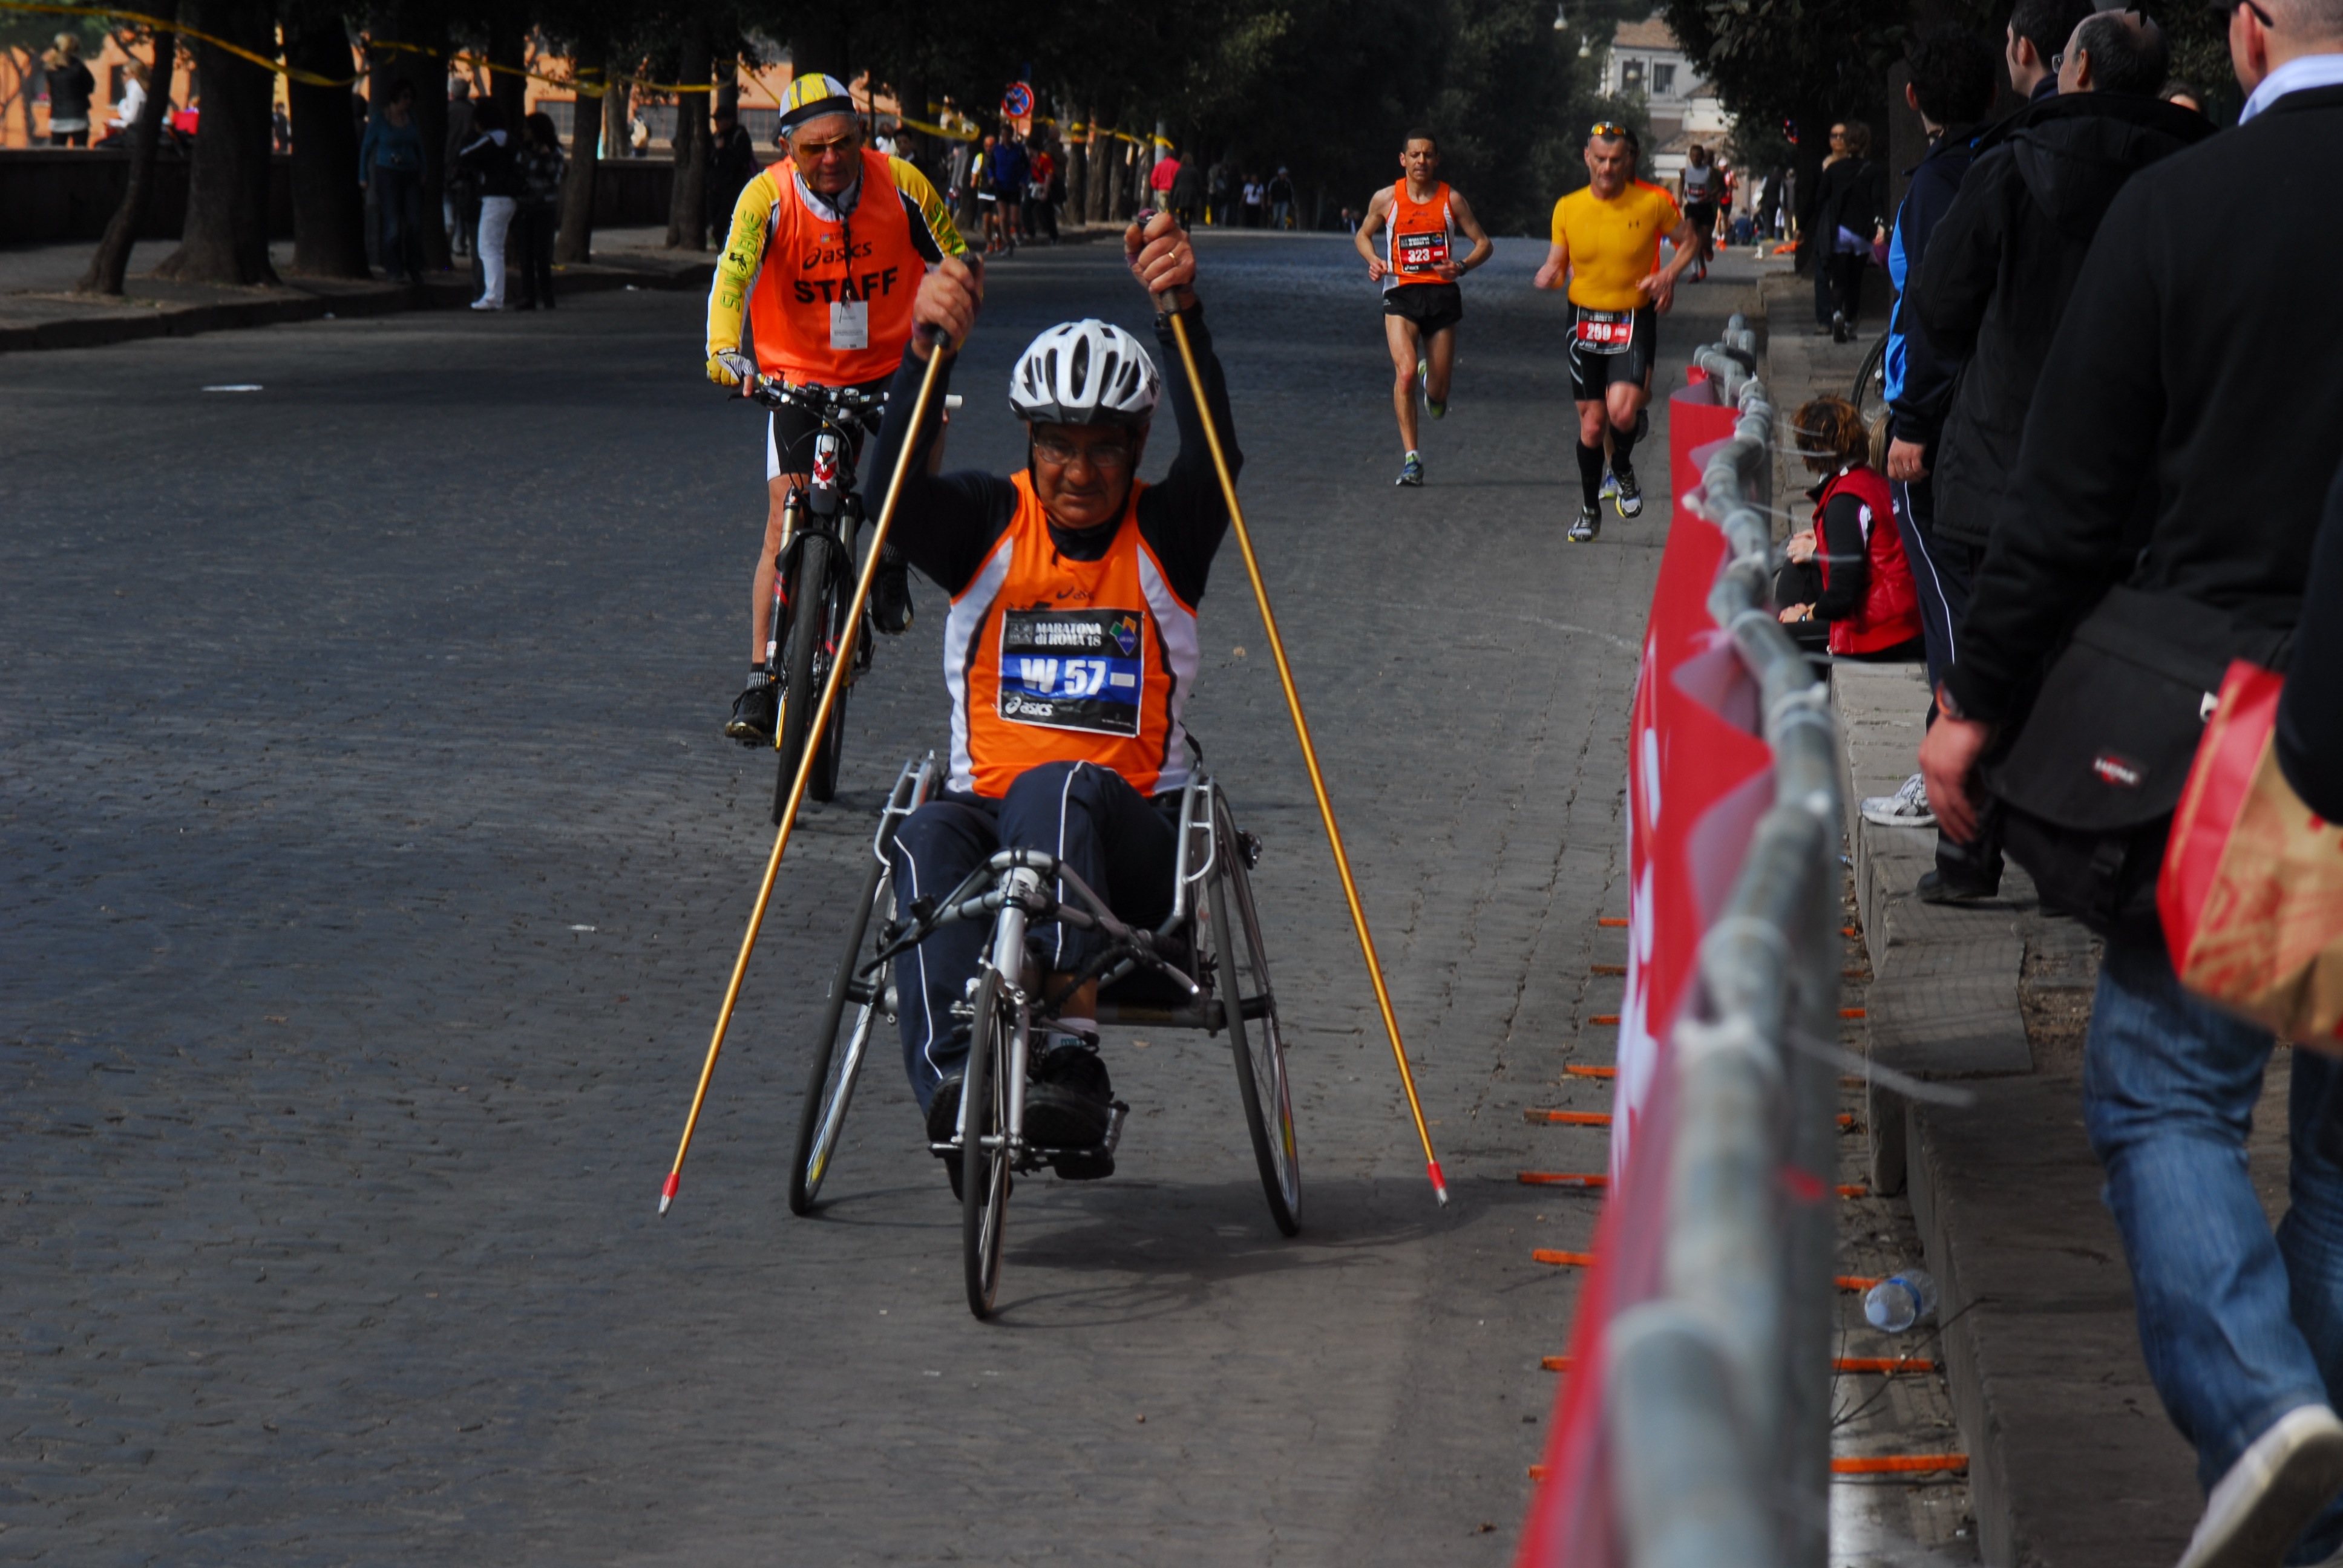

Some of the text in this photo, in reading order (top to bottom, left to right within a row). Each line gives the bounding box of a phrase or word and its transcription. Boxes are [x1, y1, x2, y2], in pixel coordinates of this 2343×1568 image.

[1407, 248, 1430, 263] 323
[793, 266, 898, 305] STAFF
[1035, 622, 1102, 635] MARATONA
[1048, 635, 1084, 646] ROMA
[1020, 658, 1106, 695] W 57
[1020, 702, 1054, 716] asics
